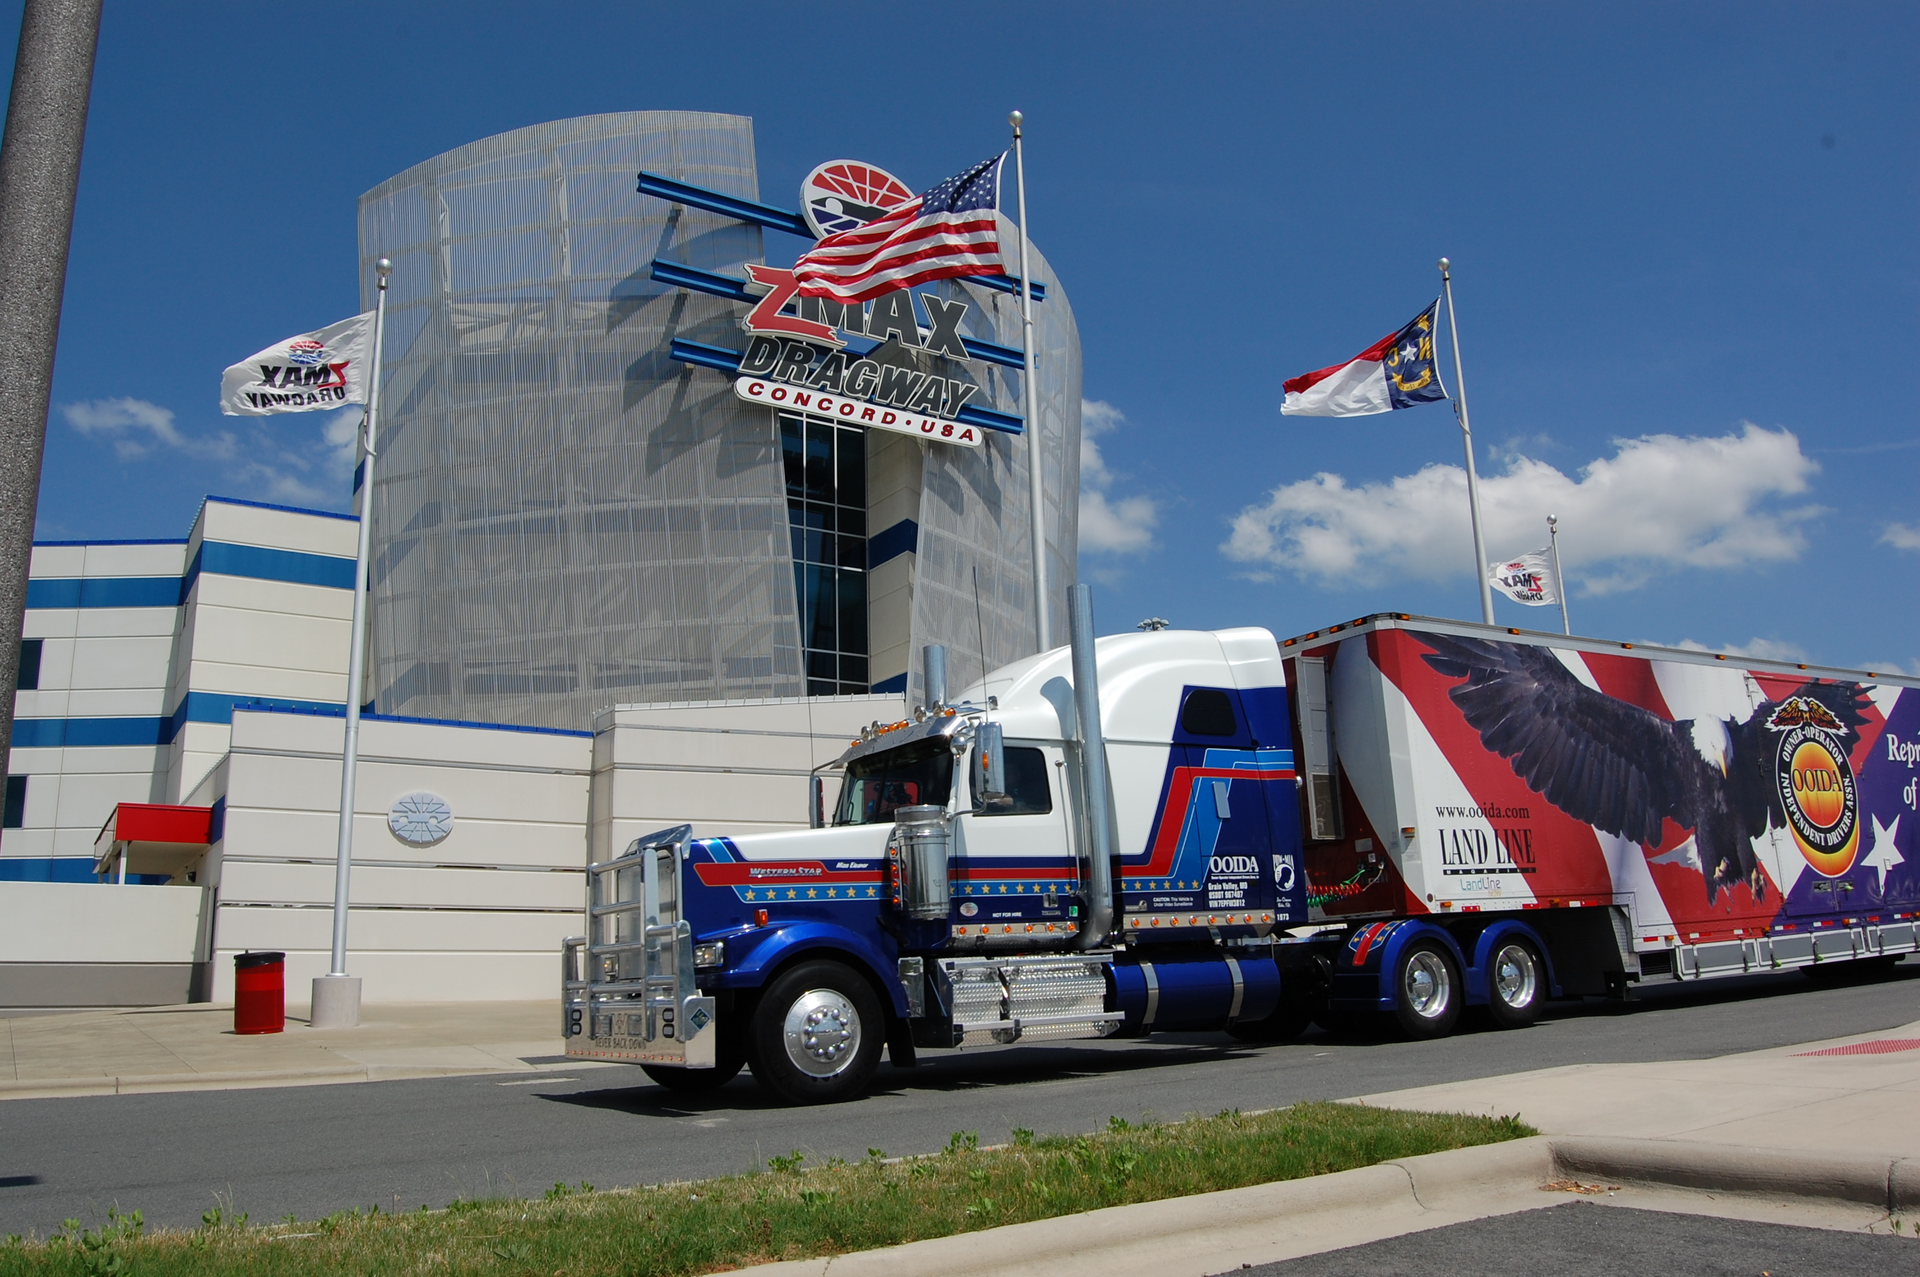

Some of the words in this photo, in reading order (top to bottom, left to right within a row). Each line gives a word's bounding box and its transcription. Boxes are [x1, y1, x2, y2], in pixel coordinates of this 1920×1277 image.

[737, 336, 978, 418] DRAGWAY
[748, 382, 897, 425] CONCORD
[921, 420, 974, 441] USA
[1782, 726, 1843, 766] OWNER-OPERATOR
[1792, 768, 1843, 792] OOIDA
[1903, 777, 1918, 810] of
[1435, 802, 1530, 819] www.ooida.com
[1781, 772, 1826, 846] INDEPENDENT
[1826, 809, 1854, 846] DRIVERS
[1842, 774, 1854, 809] ASSN.
[1438, 828, 1488, 865] LAND
[1493, 828, 1536, 864] LINE
[749, 868, 797, 876] WESTERN
[798, 867, 822, 875] STAR
[1210, 856, 1259, 873] OOIDA
[1460, 877, 1501, 891] LandLine
[613, 1038, 628, 1049] BACK
[629, 1038, 647, 1049] DOWN
